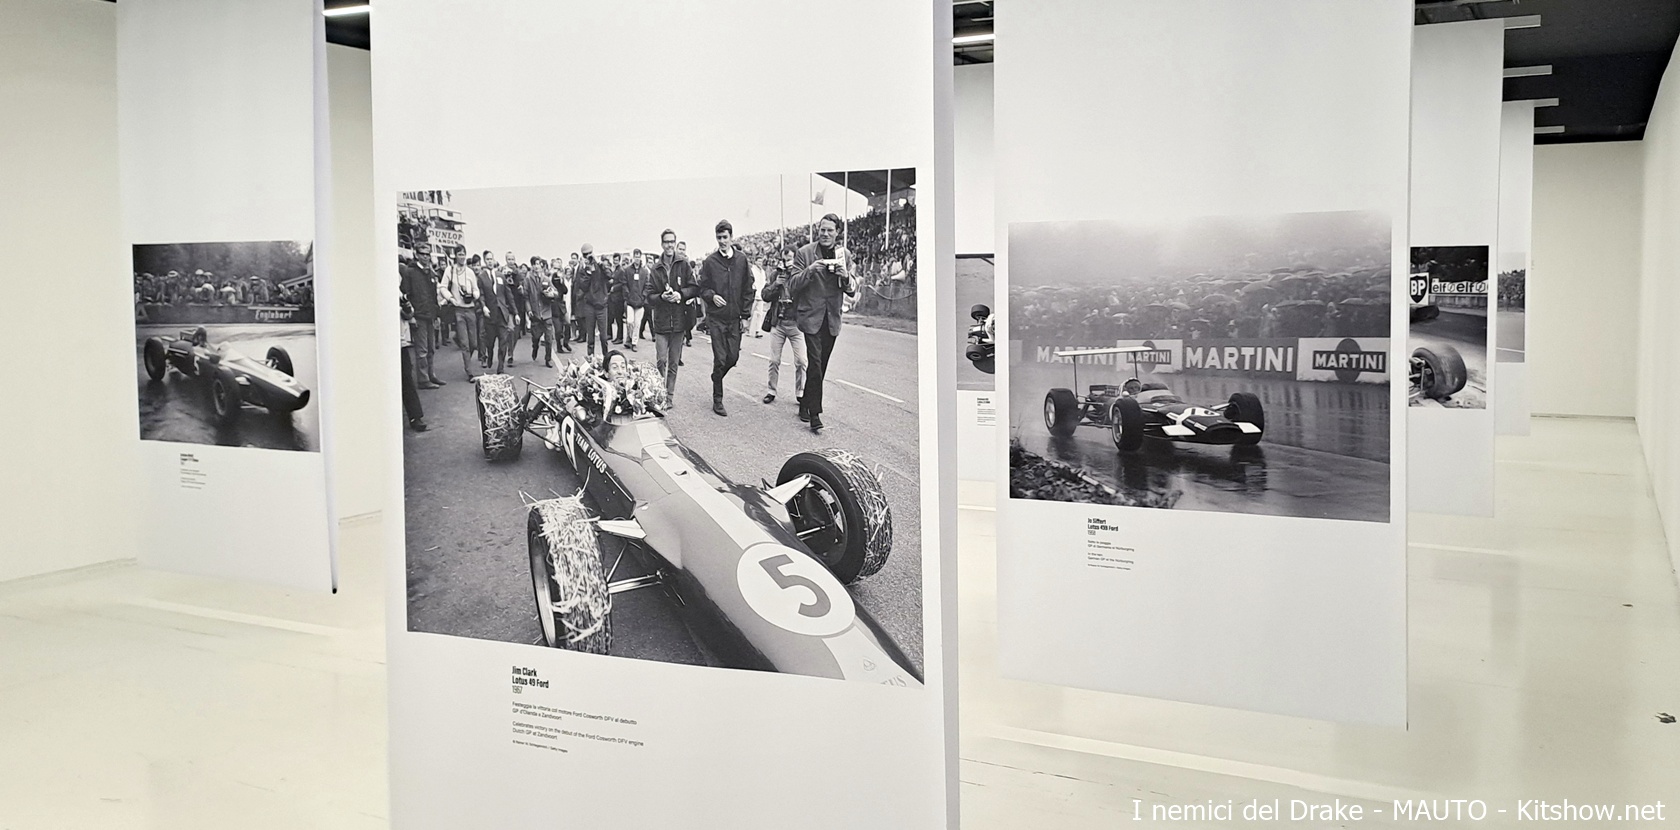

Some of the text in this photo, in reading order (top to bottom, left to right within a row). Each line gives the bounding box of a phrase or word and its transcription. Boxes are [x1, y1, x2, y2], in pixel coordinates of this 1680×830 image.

[429, 230, 463, 240] DUNLOP
[1410, 280, 1426, 296] BP
[1432, 282, 1474, 292] elf elf
[255, 310, 292, 320] Englebert
[1127, 350, 1170, 363] MARTINI
[1186, 346, 1294, 372] MARTINI
[1315, 354, 1384, 370] MARTINI
[576, 432, 606, 474] TEAM LOTUS
[758, 554, 832, 618] 5
[512, 666, 538, 677] Jim Clark
[512, 676, 528, 685] Lotus
[537, 679, 549, 688] Ford
[512, 686, 523, 694] 1967
